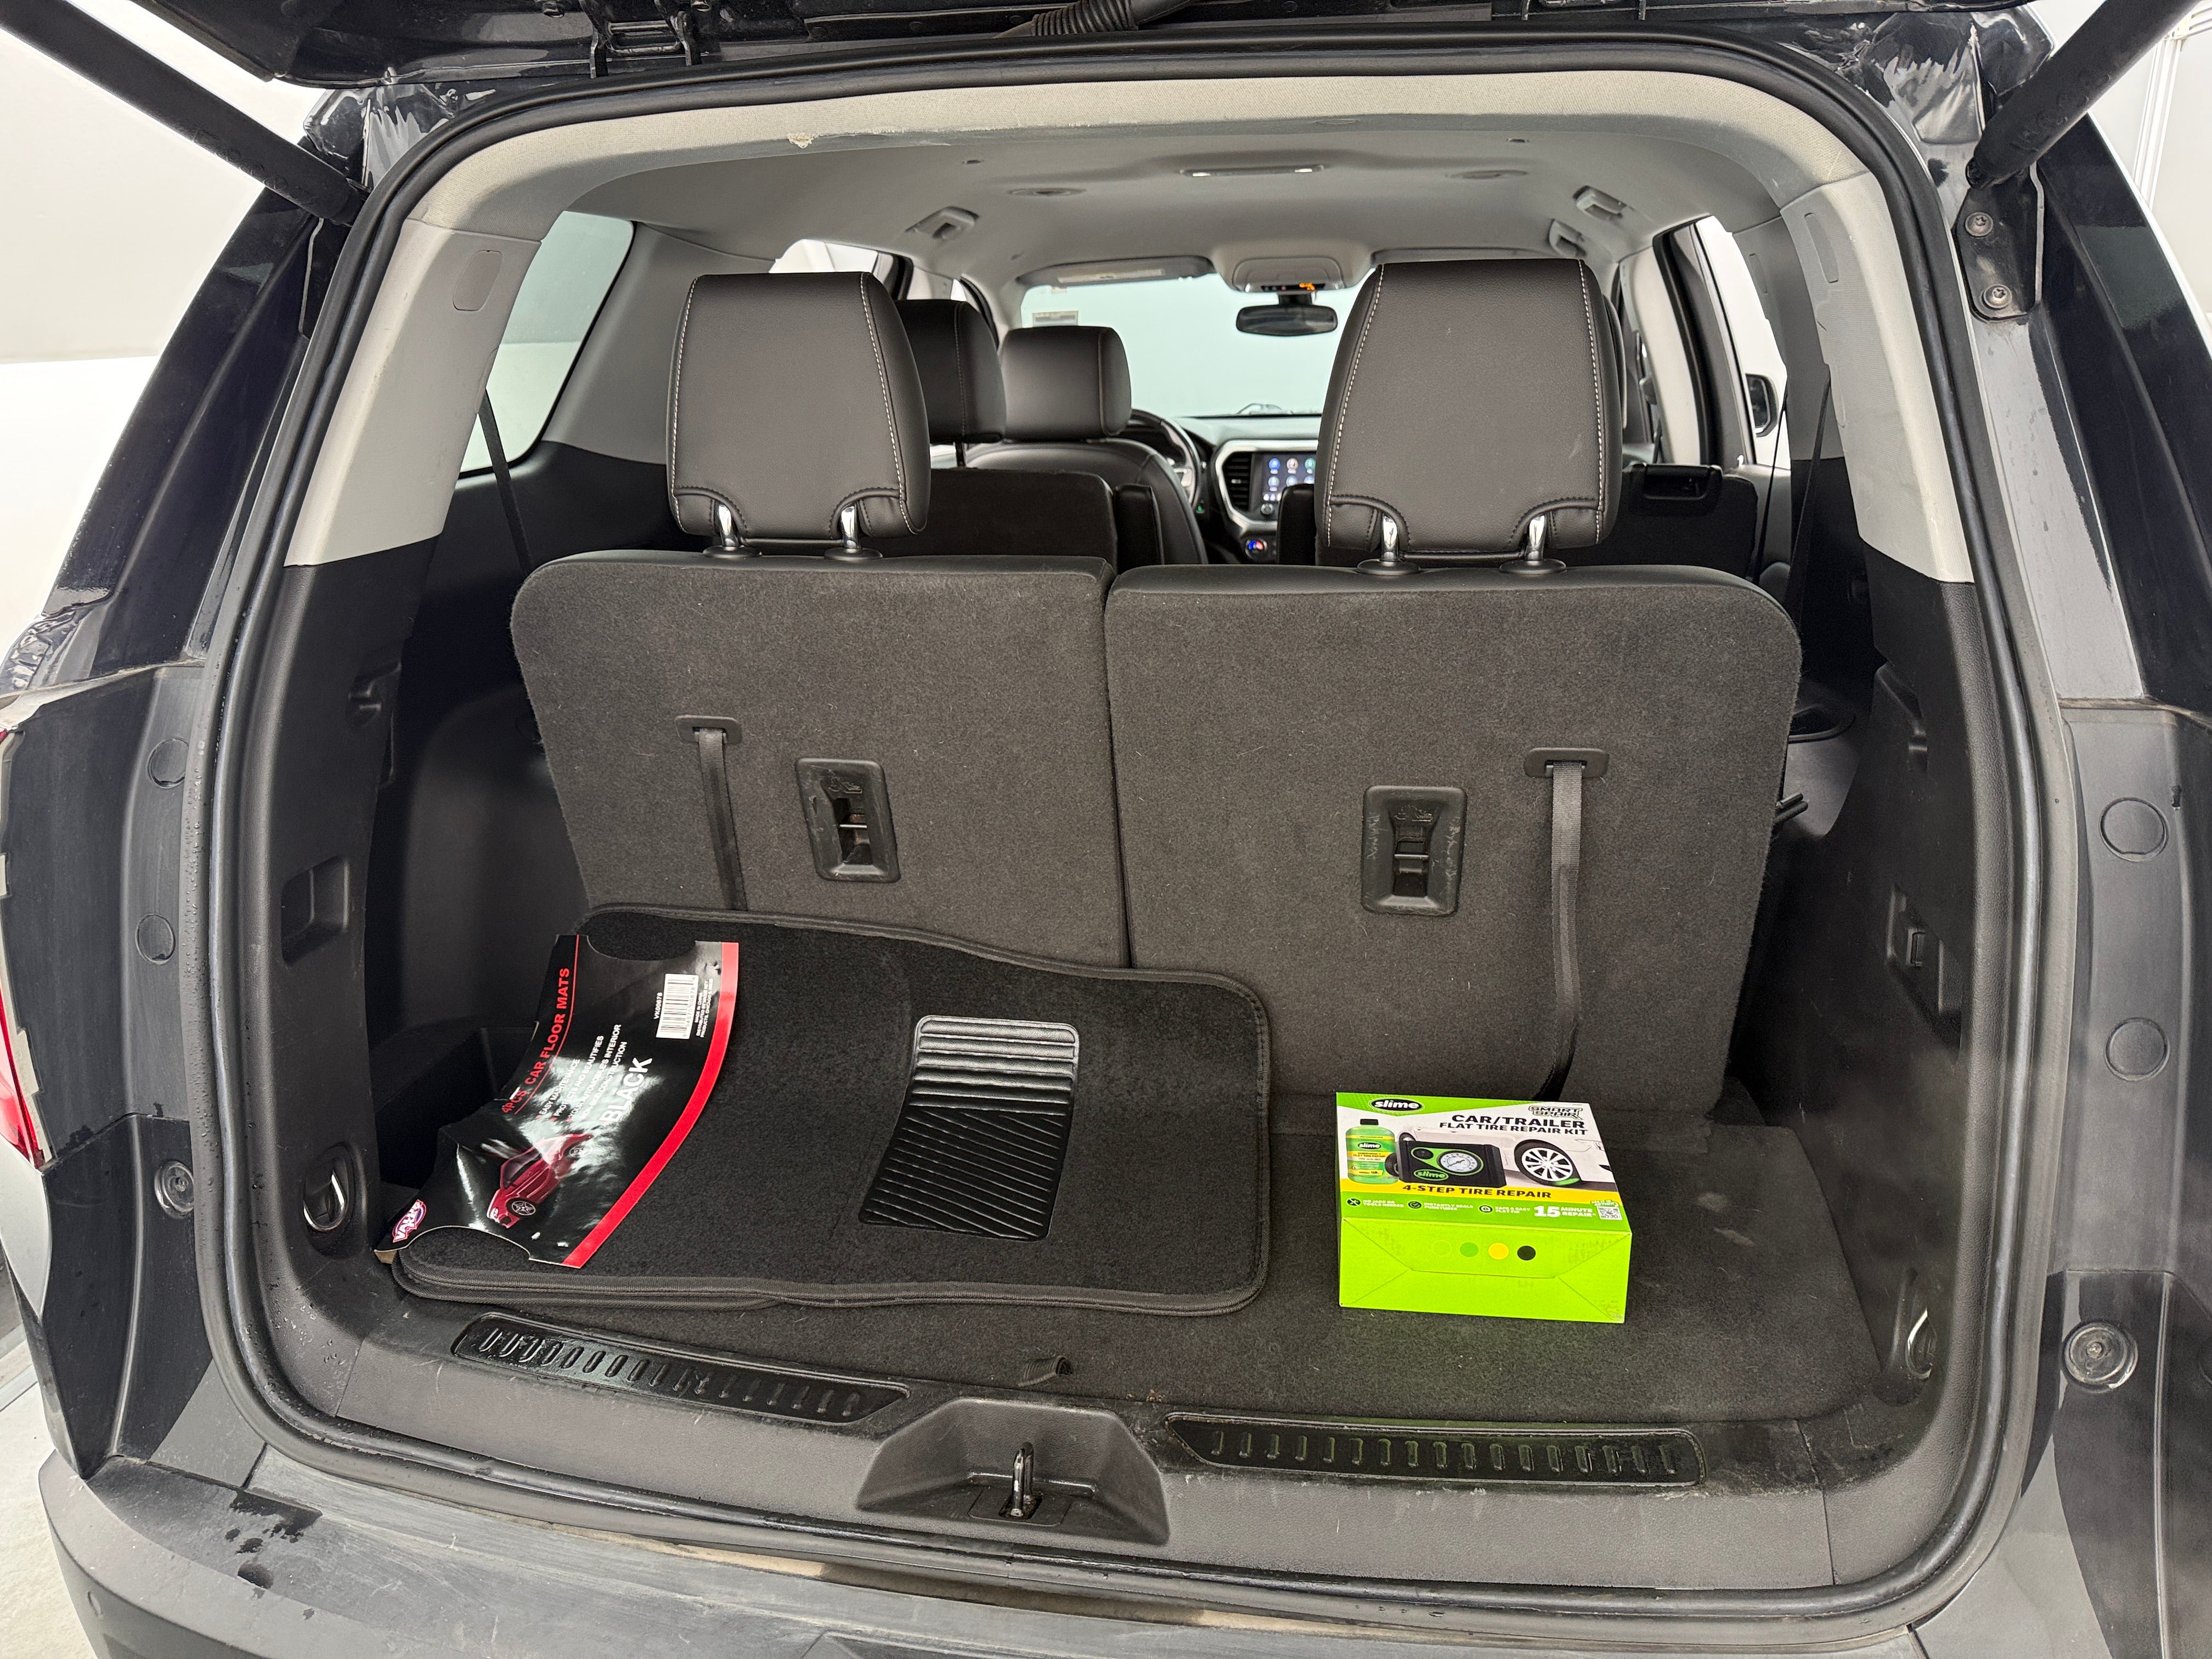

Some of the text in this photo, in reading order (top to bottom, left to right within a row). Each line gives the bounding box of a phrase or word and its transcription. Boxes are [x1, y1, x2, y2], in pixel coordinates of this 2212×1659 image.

[524, 1062, 547, 1085] CAR
[540, 1013, 566, 1058] FLOOR
[556, 968, 569, 1009] MATS
[604, 1024, 622, 1058] INTERIOR
[582, 1035, 604, 1074] BEAUTIFIES
[597, 1041, 627, 1092] CONSTRUCTION
[599, 1058, 652, 1122] BLACK
[539, 1101, 554, 1115] EASY
[1374, 1100, 1419, 1109] slime
[1452, 1115, 1585, 1128] CAR/TRAILER
[1510, 1126, 1561, 1134] REPAIR
[1402, 1184, 1455, 1194] 4-STEP
[1497, 1189, 1551, 1198] REPAIR
[1533, 1205, 1561, 1217] 15
